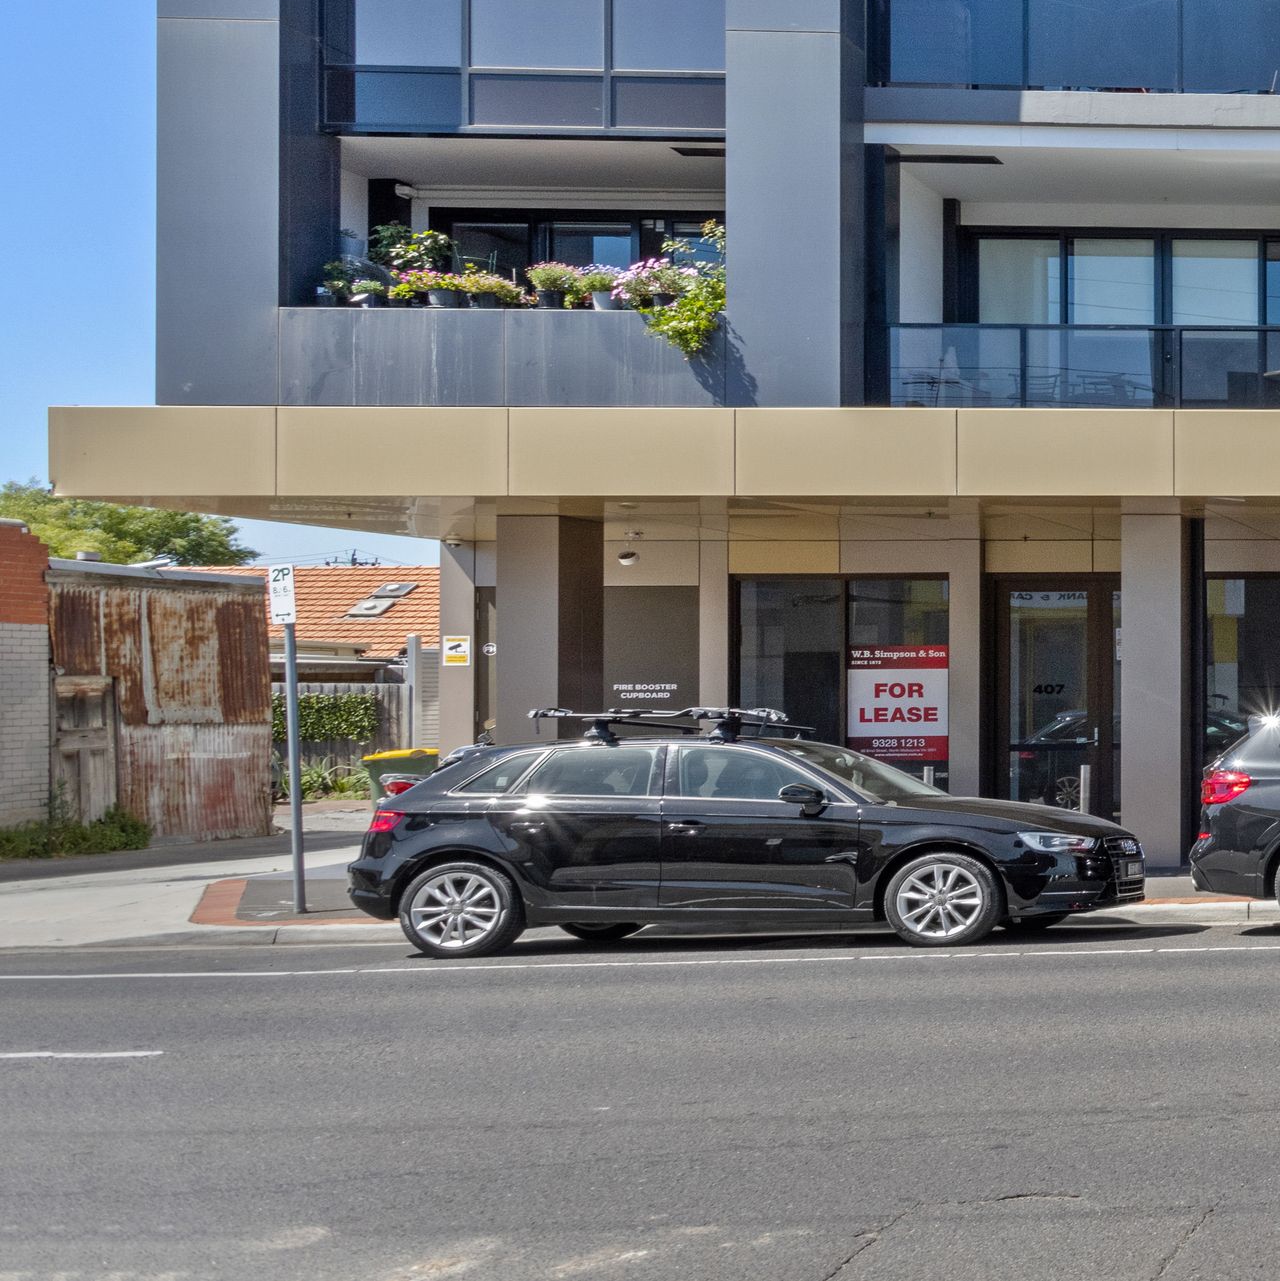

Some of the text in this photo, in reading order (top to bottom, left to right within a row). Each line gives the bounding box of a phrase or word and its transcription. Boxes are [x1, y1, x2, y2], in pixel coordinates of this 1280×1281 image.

[272, 567, 290, 582] 2P
[851, 649, 946, 660] W.B. Simpson & Son
[874, 682, 924, 699] FOR
[1033, 683, 1065, 695] 407
[859, 706, 939, 723] LEASE
[872, 738, 926, 748] 9328 1213
